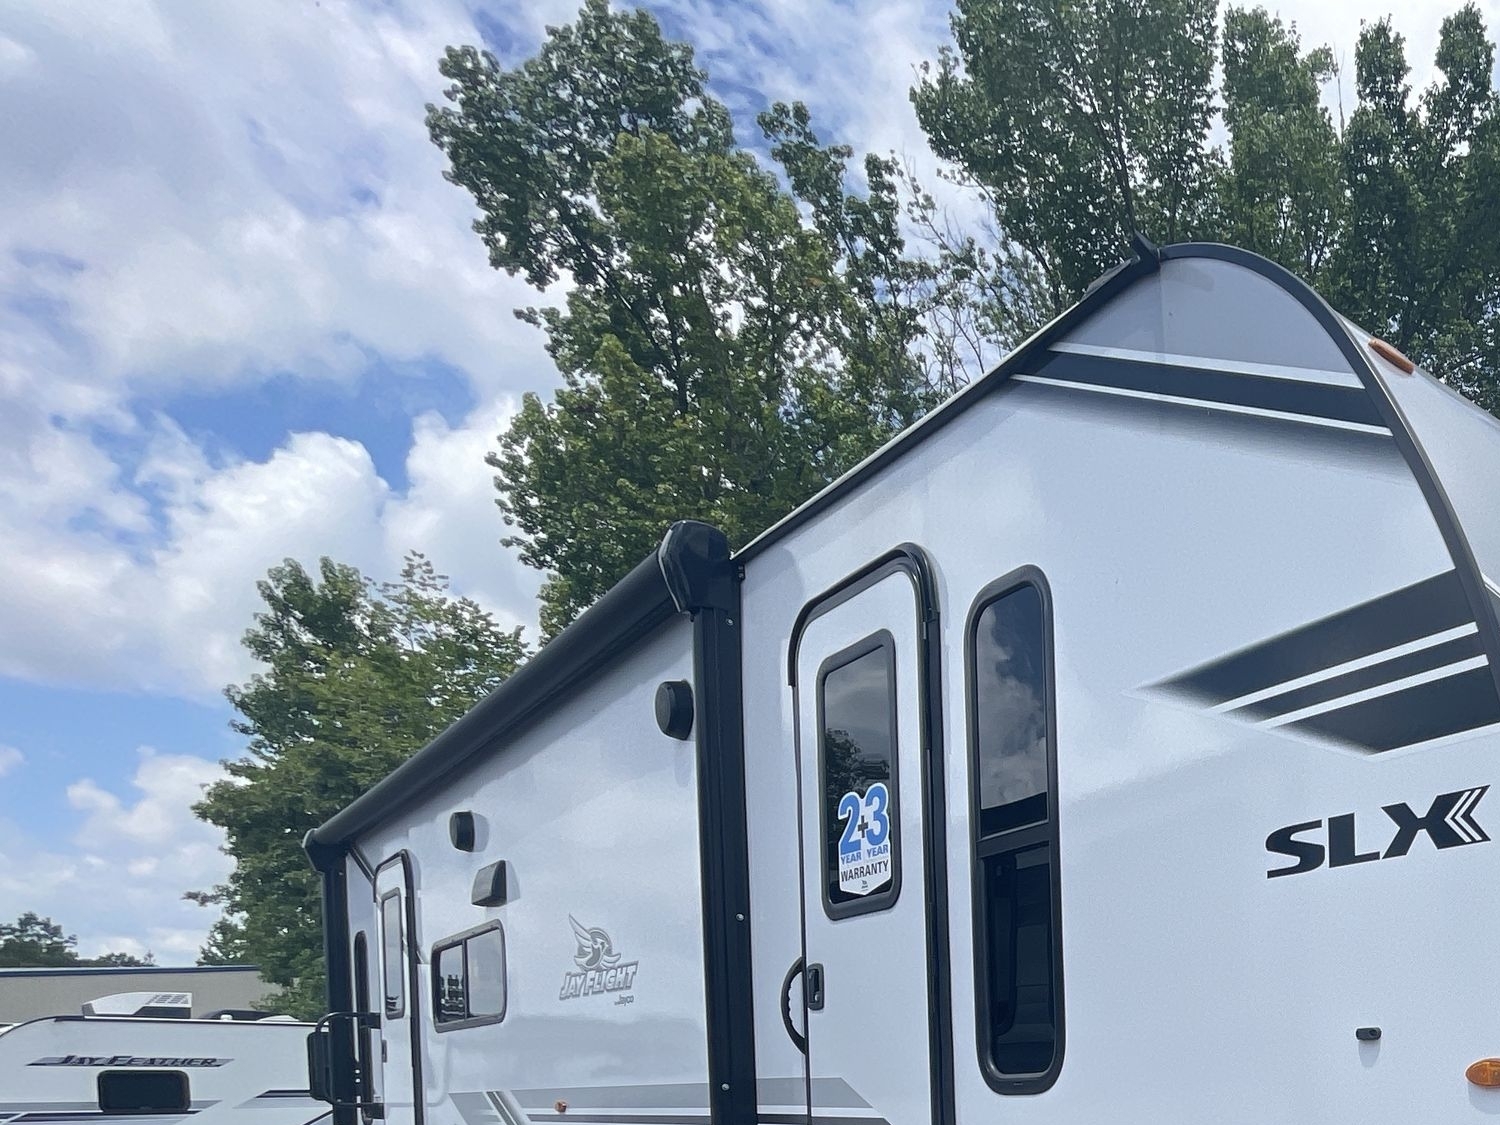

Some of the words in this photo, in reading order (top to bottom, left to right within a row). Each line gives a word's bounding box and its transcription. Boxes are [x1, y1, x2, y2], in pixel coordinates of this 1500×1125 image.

[1265, 785, 1492, 879] SLX
[840, 851, 862, 865] YEAR
[866, 844, 889, 859] YEAR
[840, 859, 889, 882] WARRANTY
[559, 972, 586, 1001] JAY
[582, 960, 639, 997] FLIGHT
[61, 1055, 102, 1066] JAY
[107, 1055, 218, 1066] FEATHER
